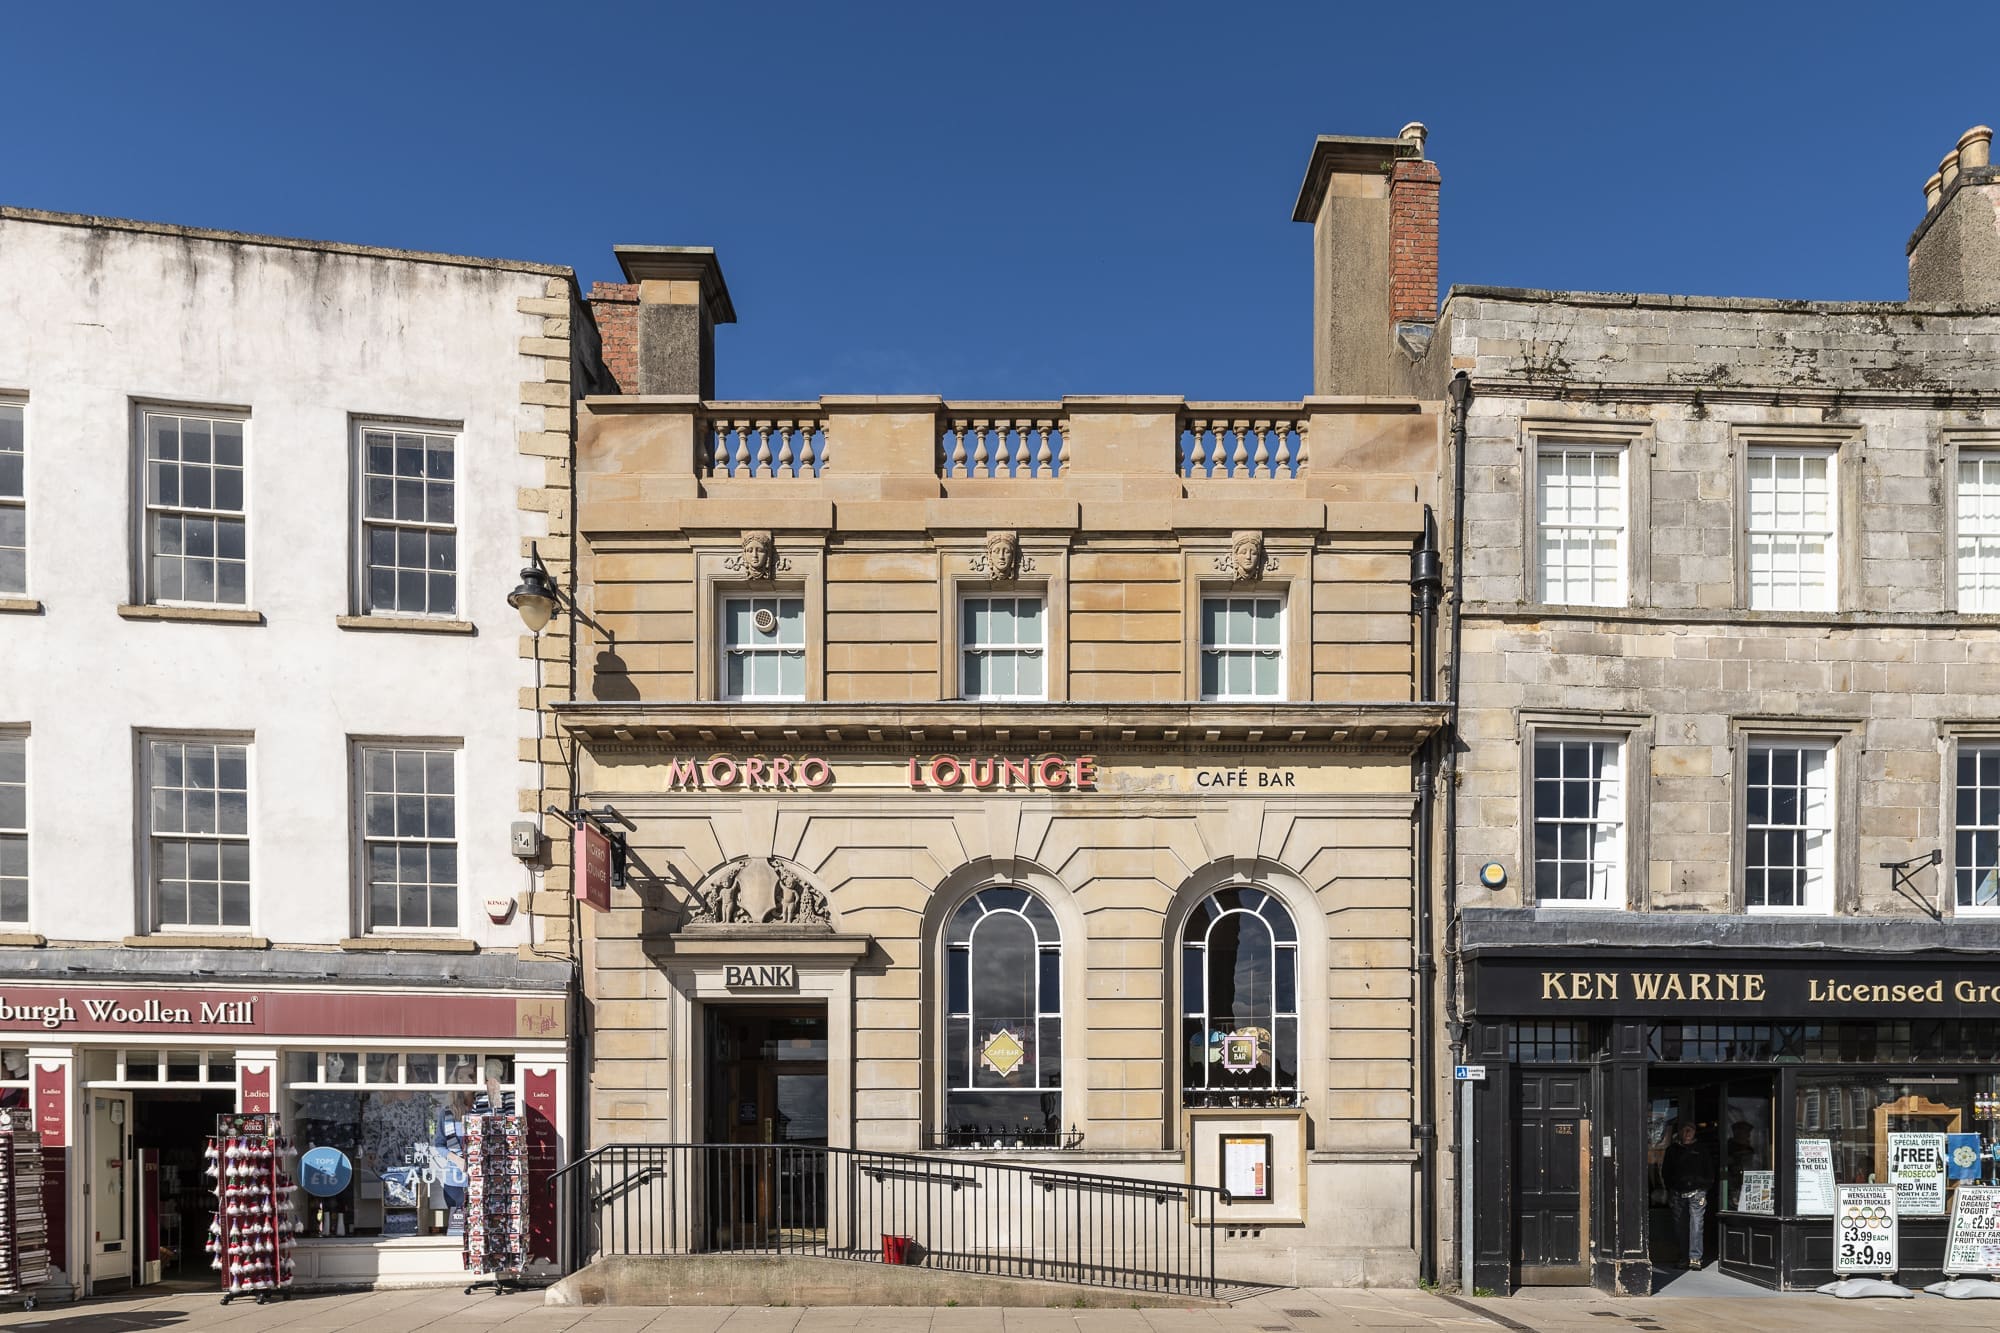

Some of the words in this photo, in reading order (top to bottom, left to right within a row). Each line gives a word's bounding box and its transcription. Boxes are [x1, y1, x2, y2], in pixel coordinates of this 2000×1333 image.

[667, 757, 831, 787] MORRO
[909, 757, 1094, 787] LOUNGE
[1197, 769, 1248, 787] CAFÉ
[1258, 772, 1295, 787] BAR
[725, 966, 791, 986] BANK
[1541, 972, 1620, 1000] KEN
[1630, 973, 1766, 1001] WARNE
[1808, 979, 1943, 1002] Licensed
[0, 996, 76, 1028] burgh
[81, 999, 193, 1024] Woollen
[244, 1090, 270, 1098] Ladies
[1901, 1148, 1934, 1163] FREE
[404, 1168, 465, 1184] AUTU
[1898, 1170, 1936, 1178] PROSECCO
[1896, 1183, 1914, 1191] RED
[1915, 1183, 1937, 1191] WINE
[1957, 1217, 1964, 1229] 2
[1972, 1215, 1995, 1230] £2.99
[1844, 1227, 1872, 1242] £3.99
[1840, 1257, 1855, 1265] FOR
[1856, 1245, 1892, 1265] £9.99
[1841, 1243, 1855, 1257] 3
